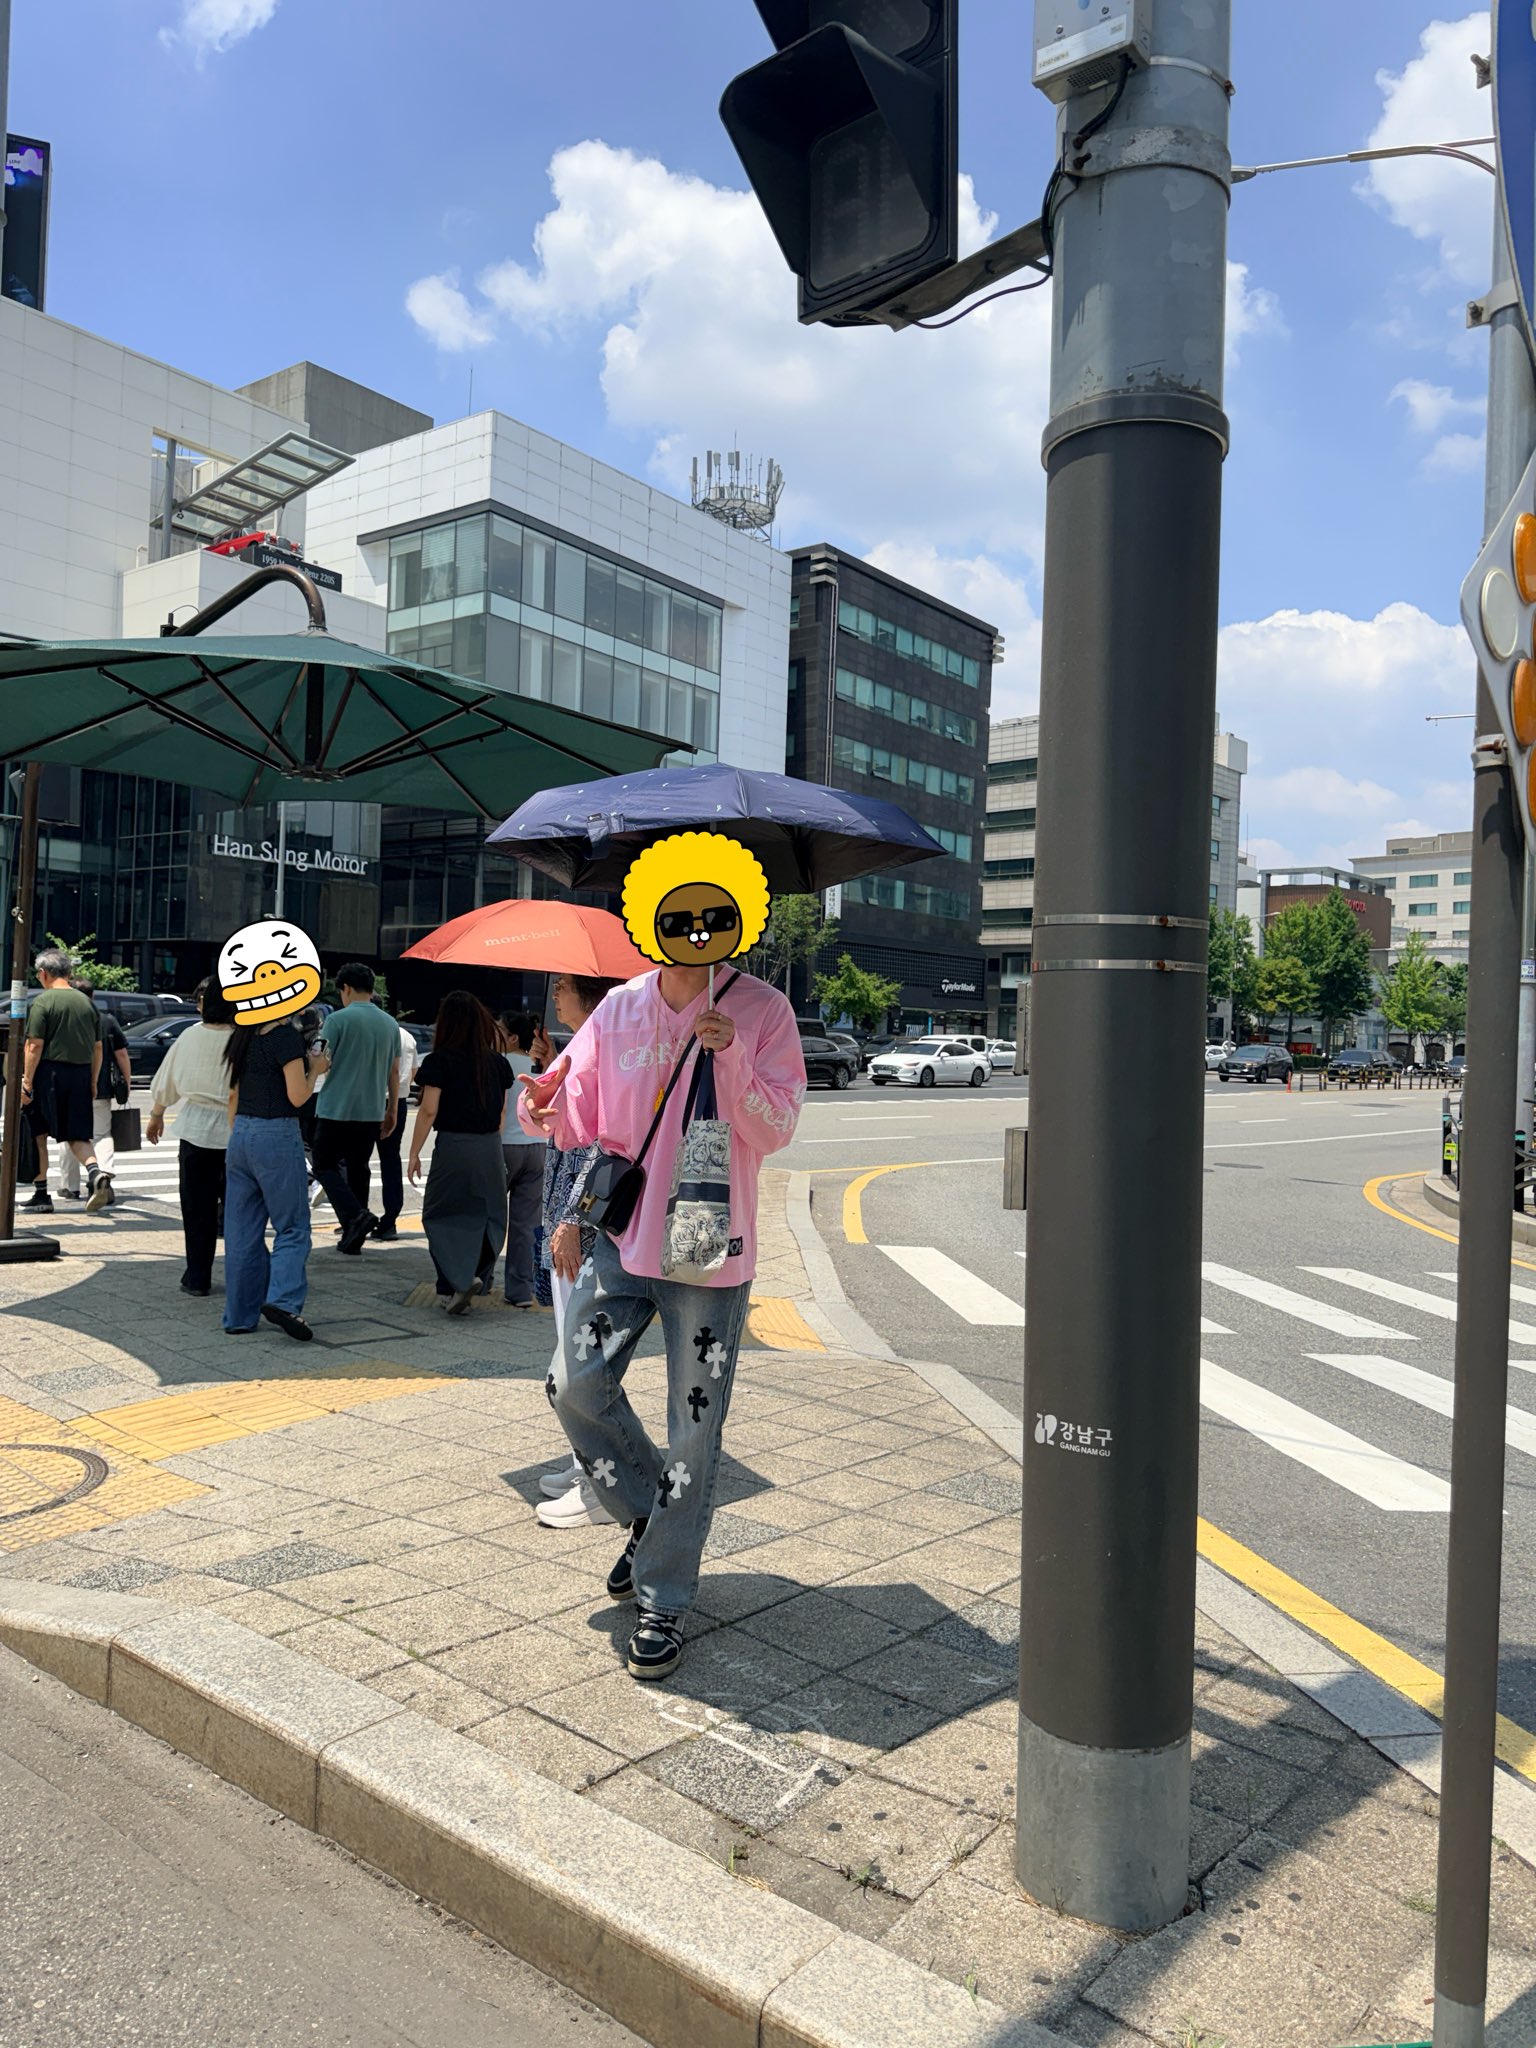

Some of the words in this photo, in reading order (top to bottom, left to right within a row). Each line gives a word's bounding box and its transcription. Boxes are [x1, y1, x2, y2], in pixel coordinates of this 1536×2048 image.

[262, 554, 278, 565] 1959
[319, 572, 336, 585] 220S
[213, 834, 253, 857] Han
[314, 849, 368, 875] Motor
[1059, 1421, 1113, 1447] 강남구
